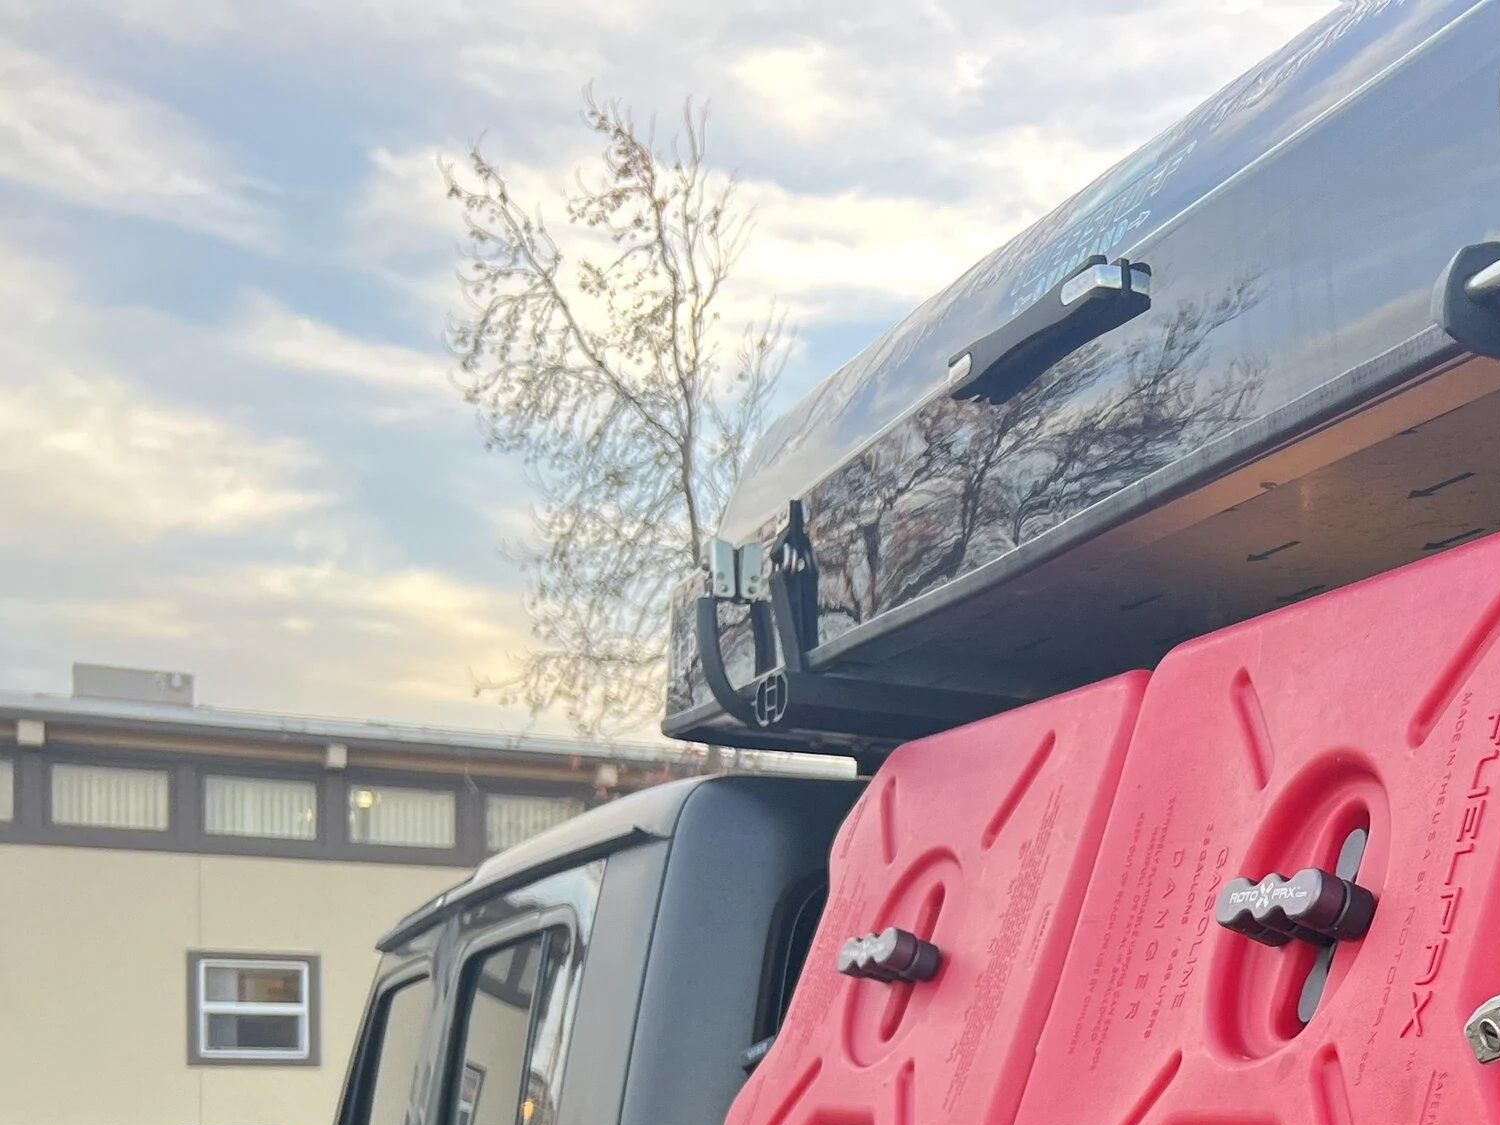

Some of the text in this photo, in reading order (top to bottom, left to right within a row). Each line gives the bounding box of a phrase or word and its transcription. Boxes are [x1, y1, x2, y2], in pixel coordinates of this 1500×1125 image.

[1452, 691, 1472, 743] MADE
[1445, 746, 1458, 767] IN
[1436, 770, 1452, 806] THE
[1411, 870, 1425, 894] BY
[1125, 847, 1185, 1020] DANGER
[1171, 847, 1229, 1010] GASOLINE
[1432, 1071, 1448, 1109] SAFE
